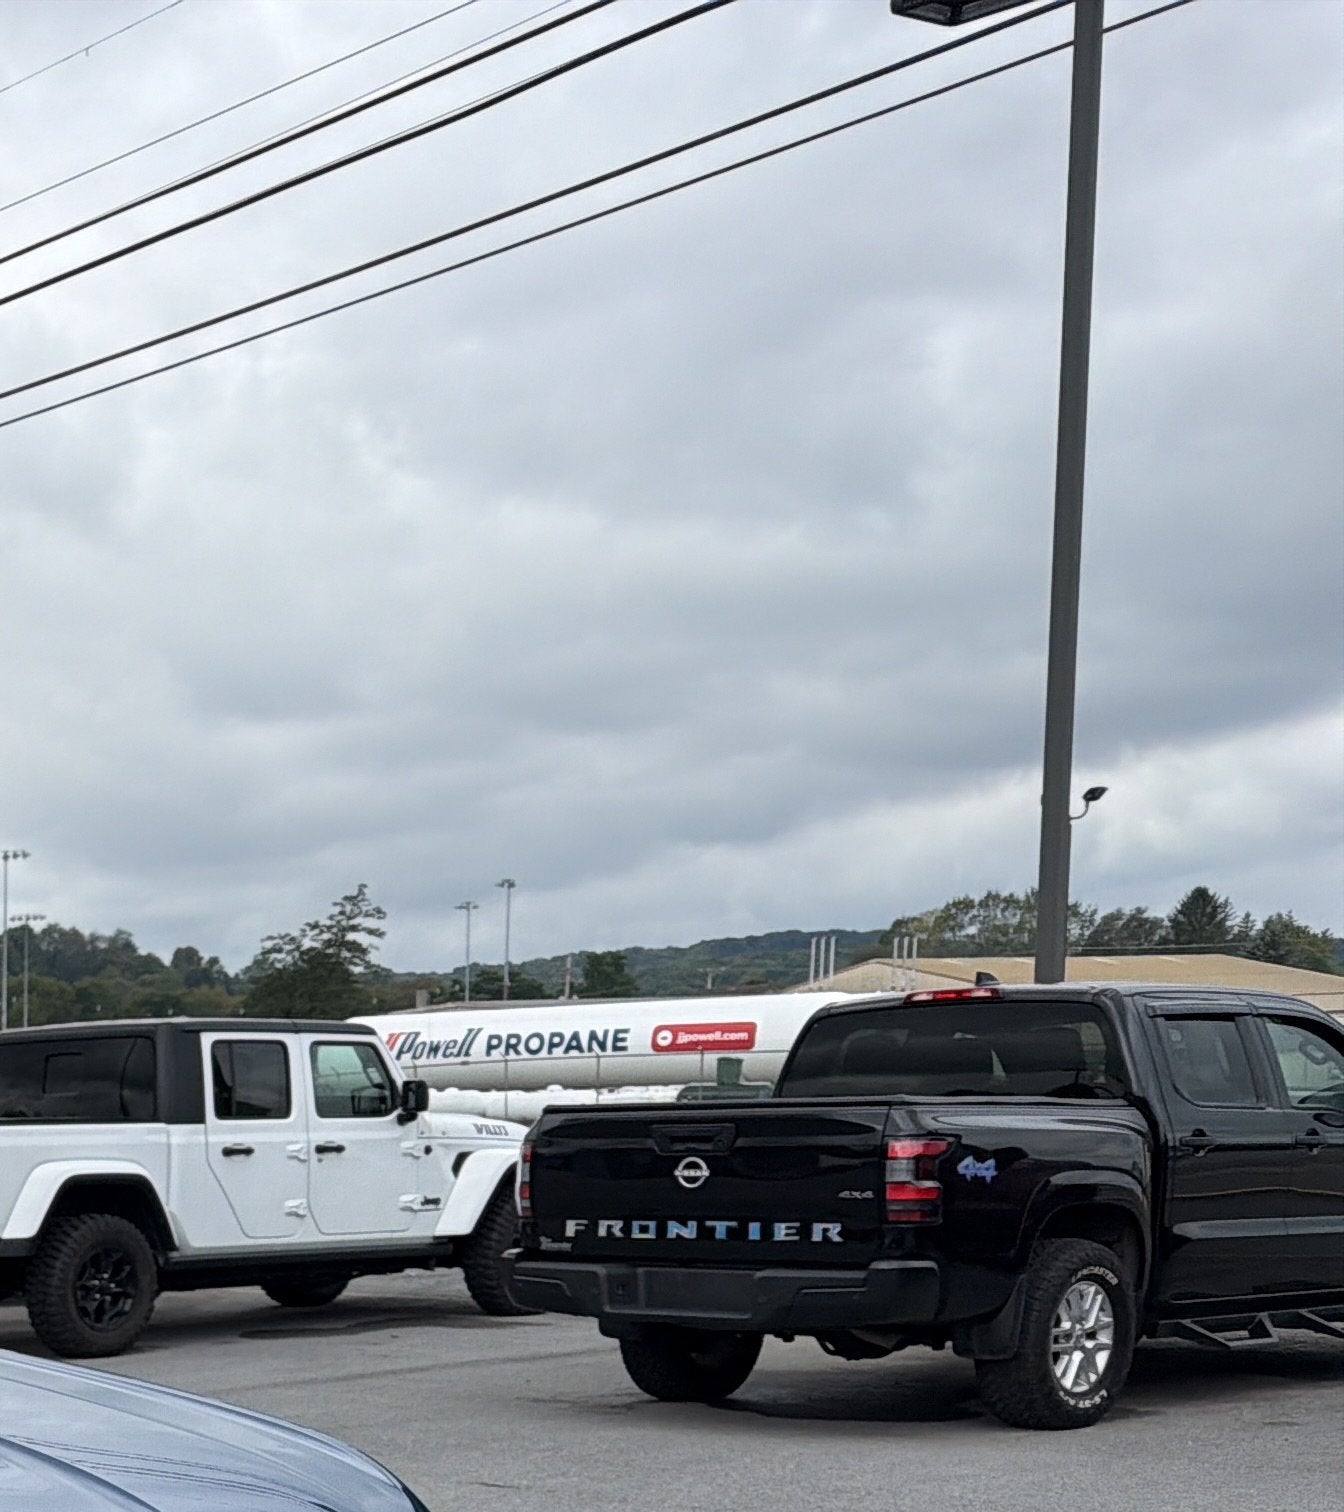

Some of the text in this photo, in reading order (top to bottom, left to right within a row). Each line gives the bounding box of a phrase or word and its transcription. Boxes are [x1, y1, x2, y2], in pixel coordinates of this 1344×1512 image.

[395, 1027, 484, 1061] Powell
[485, 1027, 632, 1058] PROPANE
[564, 1218, 845, 1243] FRONTIER
